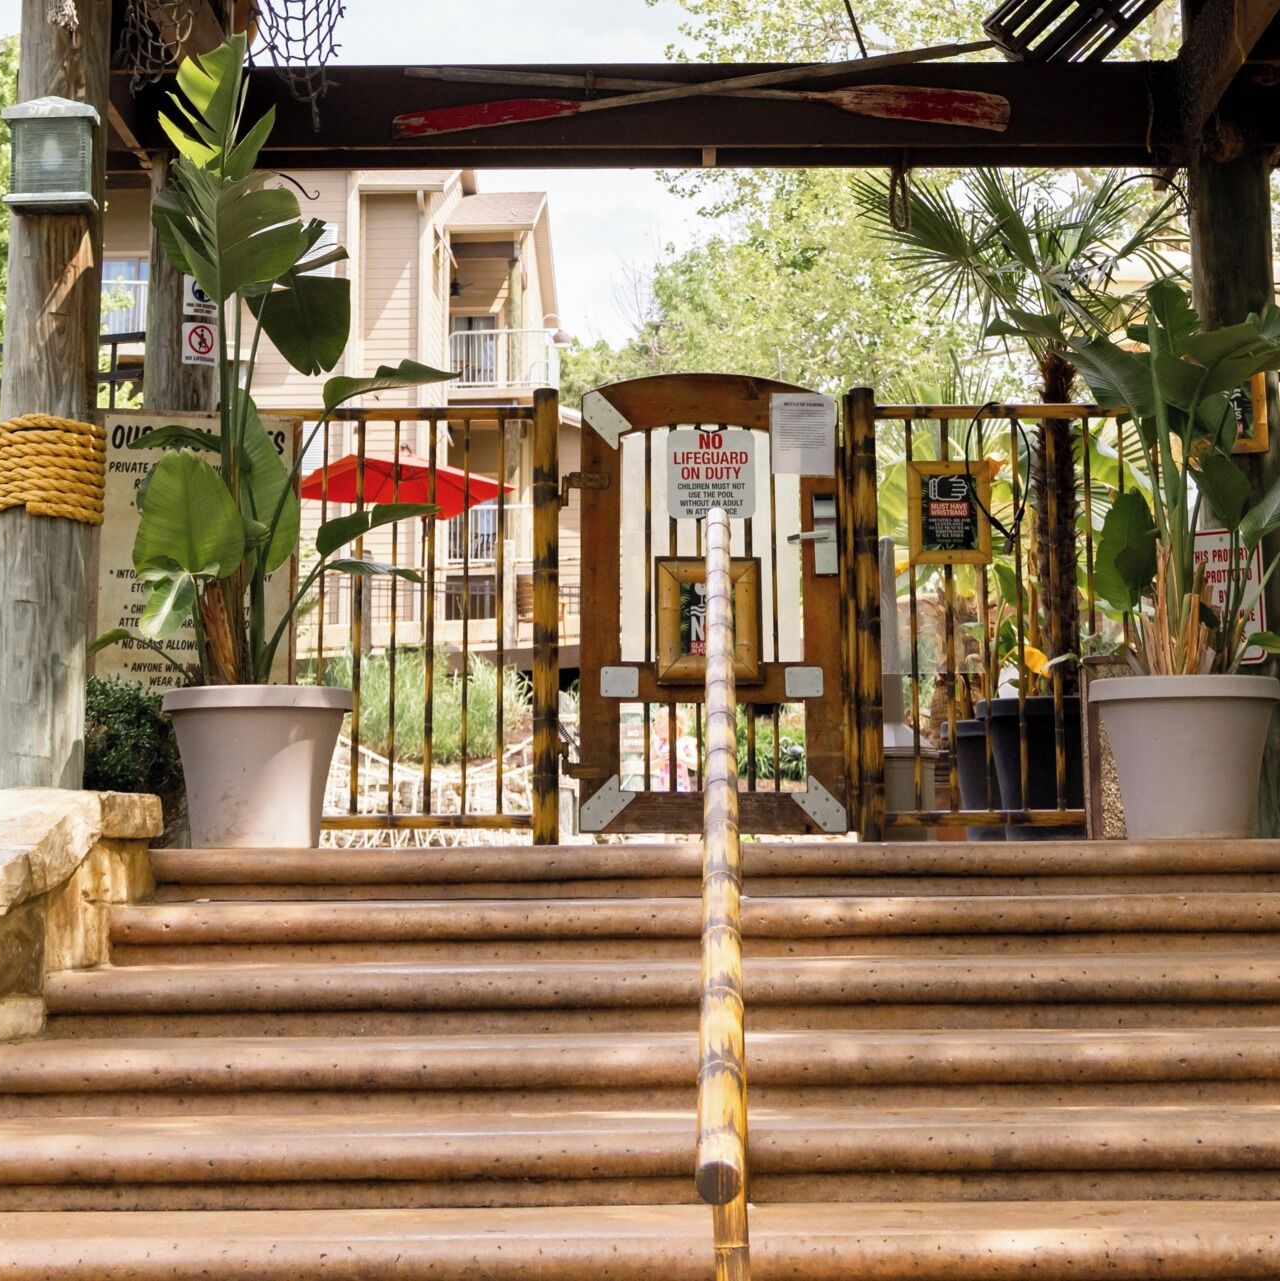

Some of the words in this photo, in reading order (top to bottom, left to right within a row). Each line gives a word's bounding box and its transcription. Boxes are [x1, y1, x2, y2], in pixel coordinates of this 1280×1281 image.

[698, 433, 723, 450] NO
[673, 451, 749, 465] LIFEGUARD
[109, 461, 149, 473] PRIVATE
[681, 467, 700, 480] ON
[705, 467, 741, 480] DUTY
[680, 499, 709, 507] WITHOUT
[711, 499, 721, 507] AN
[723, 499, 743, 507] ADULT
[1194, 550, 1208, 564] HIS
[121, 639, 134, 650] NO
[137, 638, 164, 650] GLASS
[131, 662, 163, 673] ANYONE
[150, 676, 173, 687] WEAR
